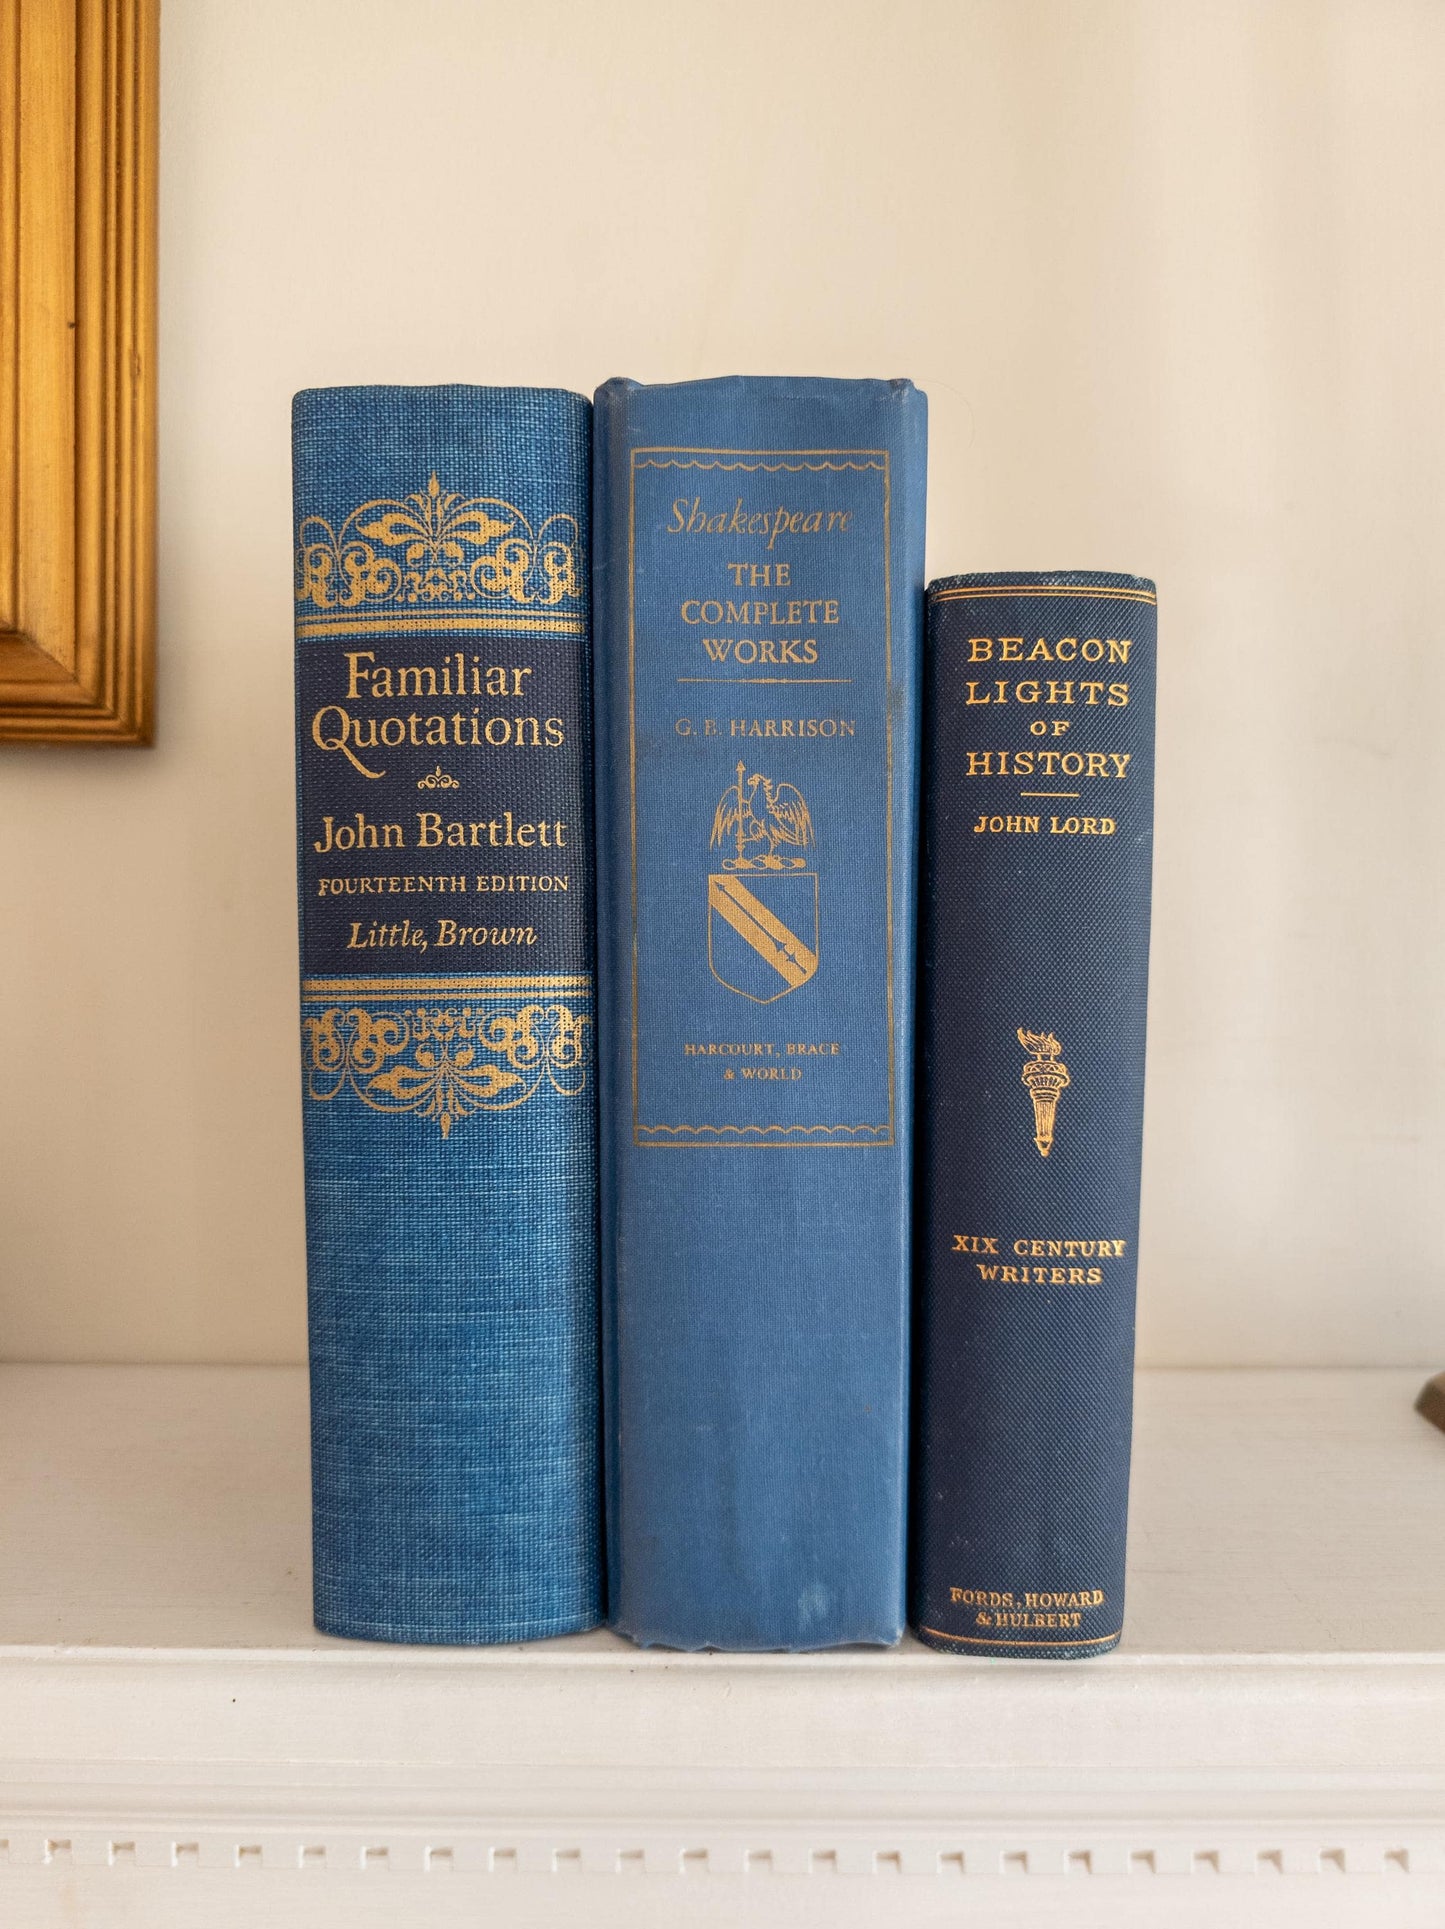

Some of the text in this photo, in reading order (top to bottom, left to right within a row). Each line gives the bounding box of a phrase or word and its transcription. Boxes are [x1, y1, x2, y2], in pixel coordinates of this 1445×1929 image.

[667, 497, 853, 550] Shakespeare
[727, 562, 792, 587] THE
[681, 600, 840, 625] COMPLETE
[702, 638, 819, 664] WORKS
[967, 637, 1132, 664] BEACON
[344, 651, 532, 699] Familiar
[965, 680, 1130, 707] LIGHTS
[675, 718, 697, 737] G.
[730, 719, 856, 737] HARRISON
[1030, 720, 1071, 736] OF
[312, 705, 565, 779] Quotations
[966, 751, 1131, 779] HISTORY
[314, 811, 568, 853] John Bartlett
[973, 815, 1117, 836] JOHN LORD
[318, 875, 569, 897] FOURTEENTH EDITION
[347, 919, 538, 954] Little, Brown
[684, 1042, 841, 1058] HARCOURT, BRACE
[722, 1067, 802, 1081] & WORLD
[952, 1234, 1127, 1258] XIX CENTURY
[976, 1263, 1104, 1285] WRITERS
[950, 1587, 1105, 1609] FORDS, HOWARD
[995, 1611, 1082, 1628] HULBERT
